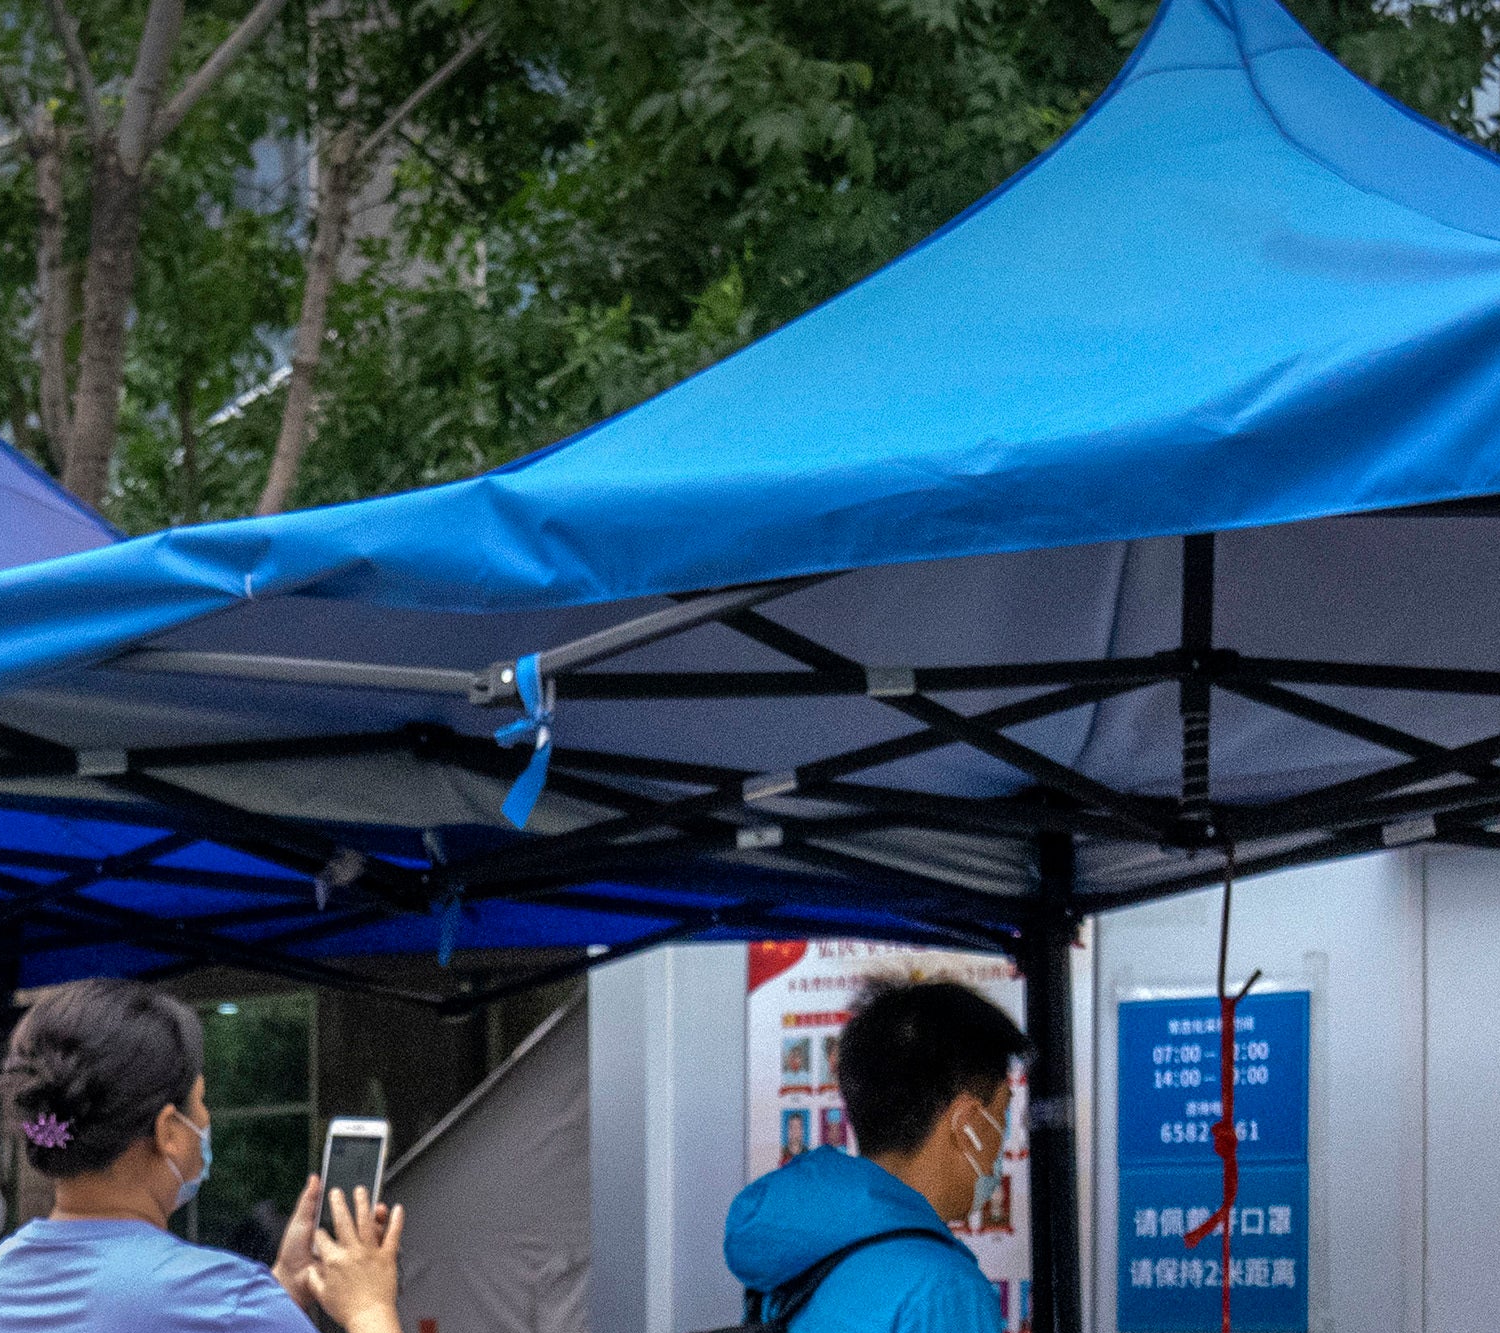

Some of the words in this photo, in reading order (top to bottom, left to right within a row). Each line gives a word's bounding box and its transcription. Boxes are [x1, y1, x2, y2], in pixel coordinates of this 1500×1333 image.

[1152, 1040, 1270, 1065] 07:00-:00
[1154, 1065, 1269, 1089] 14:00-:00
[1160, 1120, 1259, 1143] 658261
